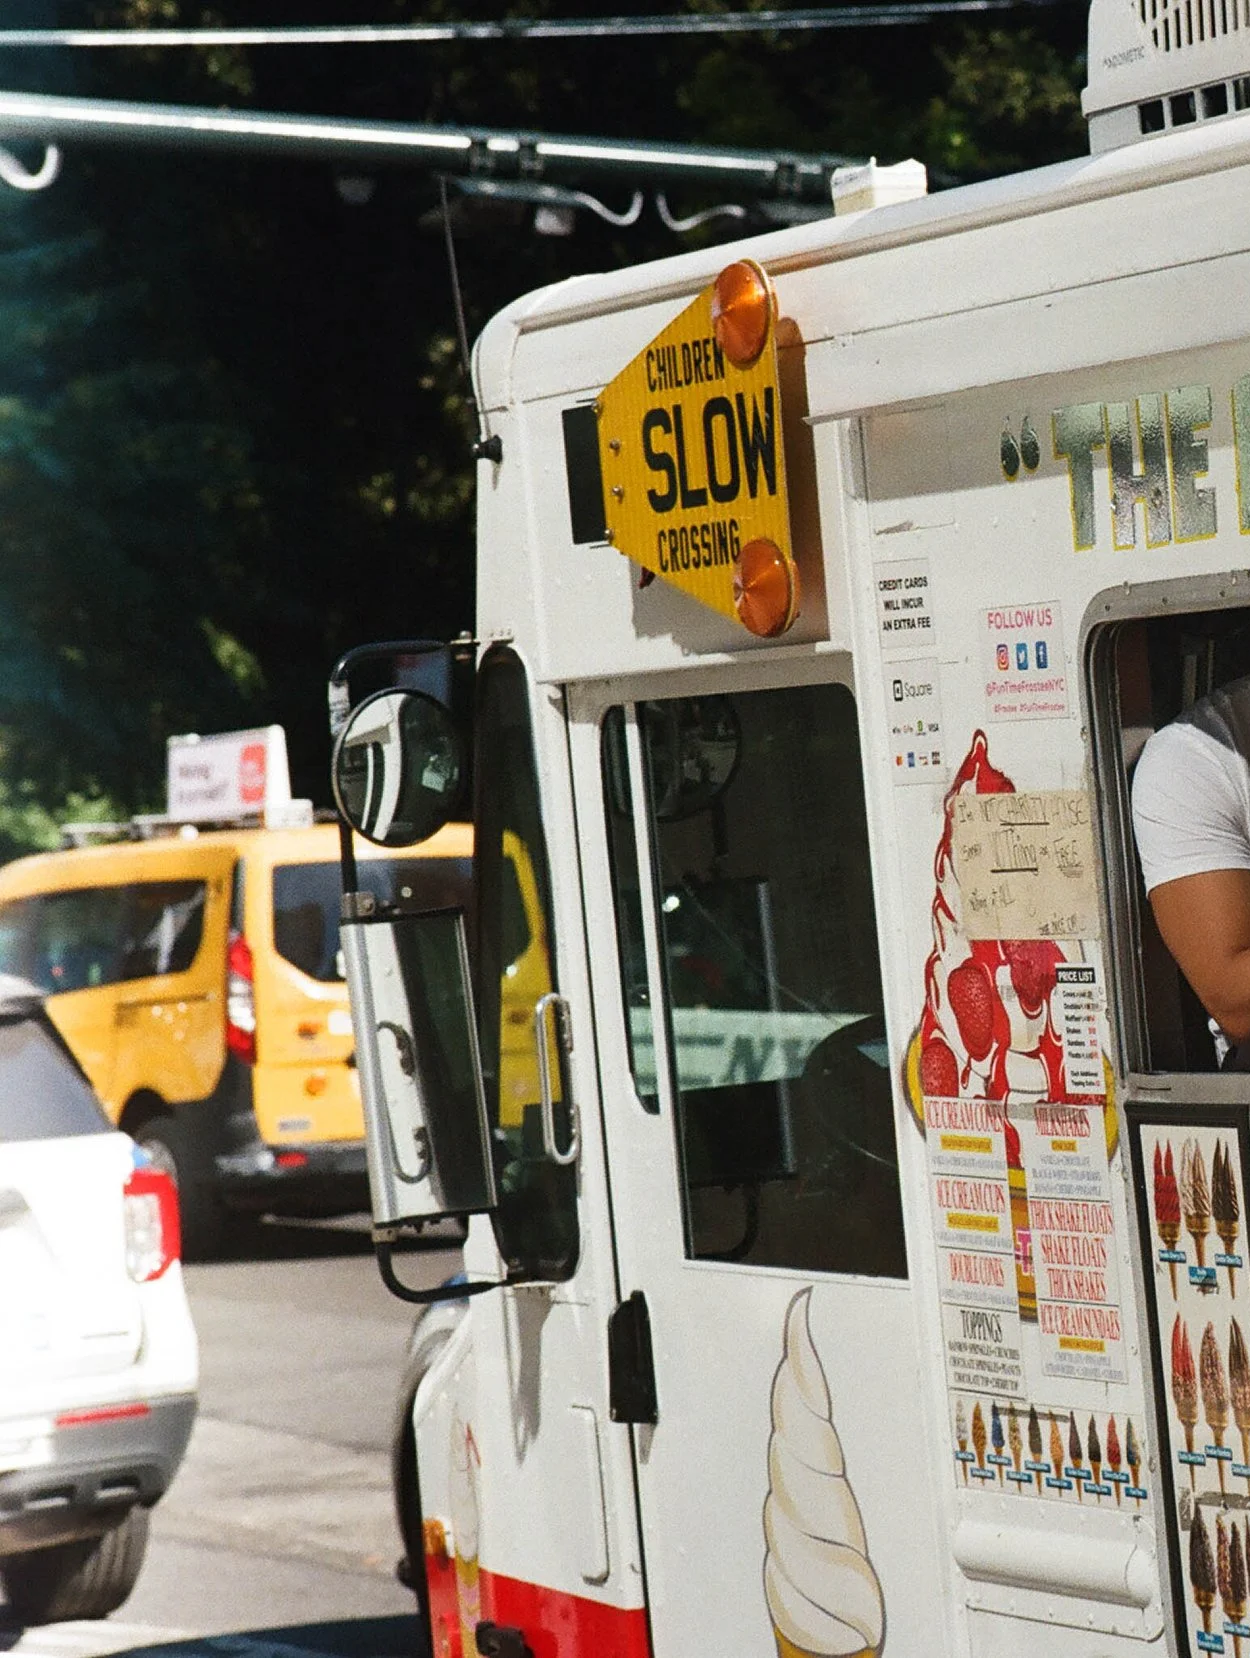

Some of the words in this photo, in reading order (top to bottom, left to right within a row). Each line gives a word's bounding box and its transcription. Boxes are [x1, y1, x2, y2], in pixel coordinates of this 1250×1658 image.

[646, 336, 724, 392] CHILDREN
[642, 387, 777, 513] SLOW
[658, 519, 741, 572] CROSSING
[878, 578, 902, 592] CREDIT
[904, 576, 928, 590] CARDS
[884, 599, 900, 611] WILL
[902, 597, 923, 609] INCUR
[987, 610, 1035, 629] FOLLOW
[1036, 608, 1053, 626] US
[882, 619, 892, 631] AN
[893, 618, 916, 630] EXTRA
[917, 616, 931, 628] FEE
[904, 681, 933, 698] Square
[1058, 970, 1078, 983] PRICE
[1078, 969, 1094, 982] LIST
[925, 1100, 941, 1128] ICE
[941, 1102, 974, 1131] CREAM
[936, 1179, 952, 1208] ICE
[952, 1180, 983, 1212] CREAM
[983, 1182, 1006, 1213] CUPS
[1030, 1200, 1055, 1231] THICK
[1055, 1201, 1082, 1232] SHAKE
[1082, 1203, 1114, 1234] FLOATS
[1040, 1234, 1071, 1265] SHAKE
[1071, 1236, 1107, 1268] FLOATS
[949, 1253, 980, 1284] DOUBLE
[980, 1256, 1005, 1288] CONES
[1047, 1268, 1074, 1299] THICK
[1073, 1271, 1107, 1301] SHAKES
[960, 1309, 1003, 1344] TOPPINGS
[1040, 1303, 1055, 1334] ICE
[1055, 1306, 1083, 1336] CREAM
[1083, 1308, 1121, 1341] SUNDAES
